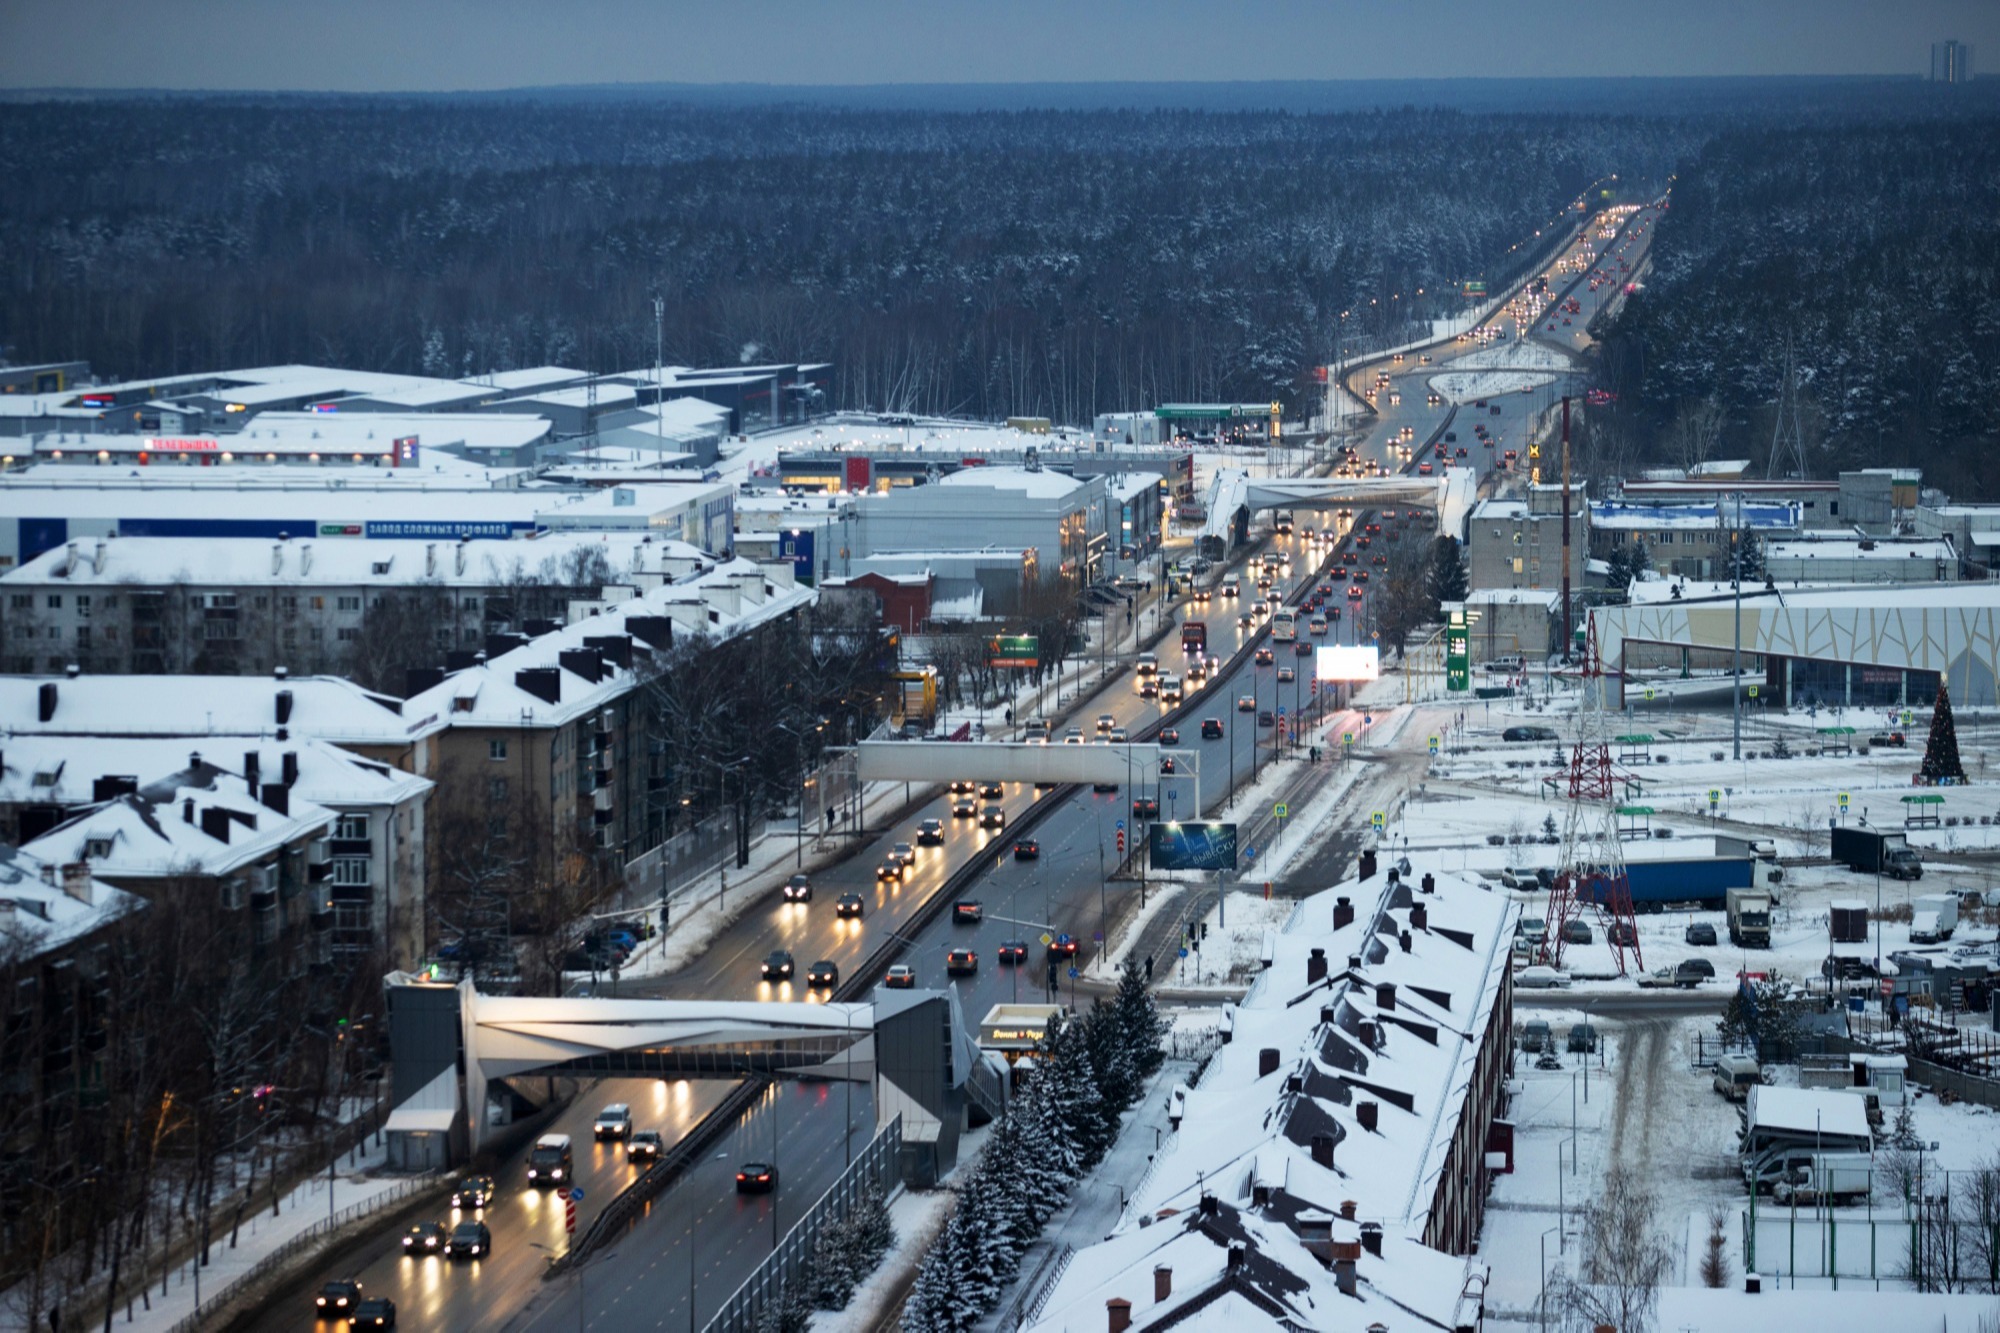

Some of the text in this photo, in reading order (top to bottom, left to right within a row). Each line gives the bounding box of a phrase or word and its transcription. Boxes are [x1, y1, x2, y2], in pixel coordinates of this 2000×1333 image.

[369, 524, 402, 535] ЗАВОД
[403, 524, 453, 535] СЛОЖНЫХ
[454, 523, 507, 535] ПРОФИЛЕЙ
[1193, 839, 1235, 864] ВЫВЕСКИ
